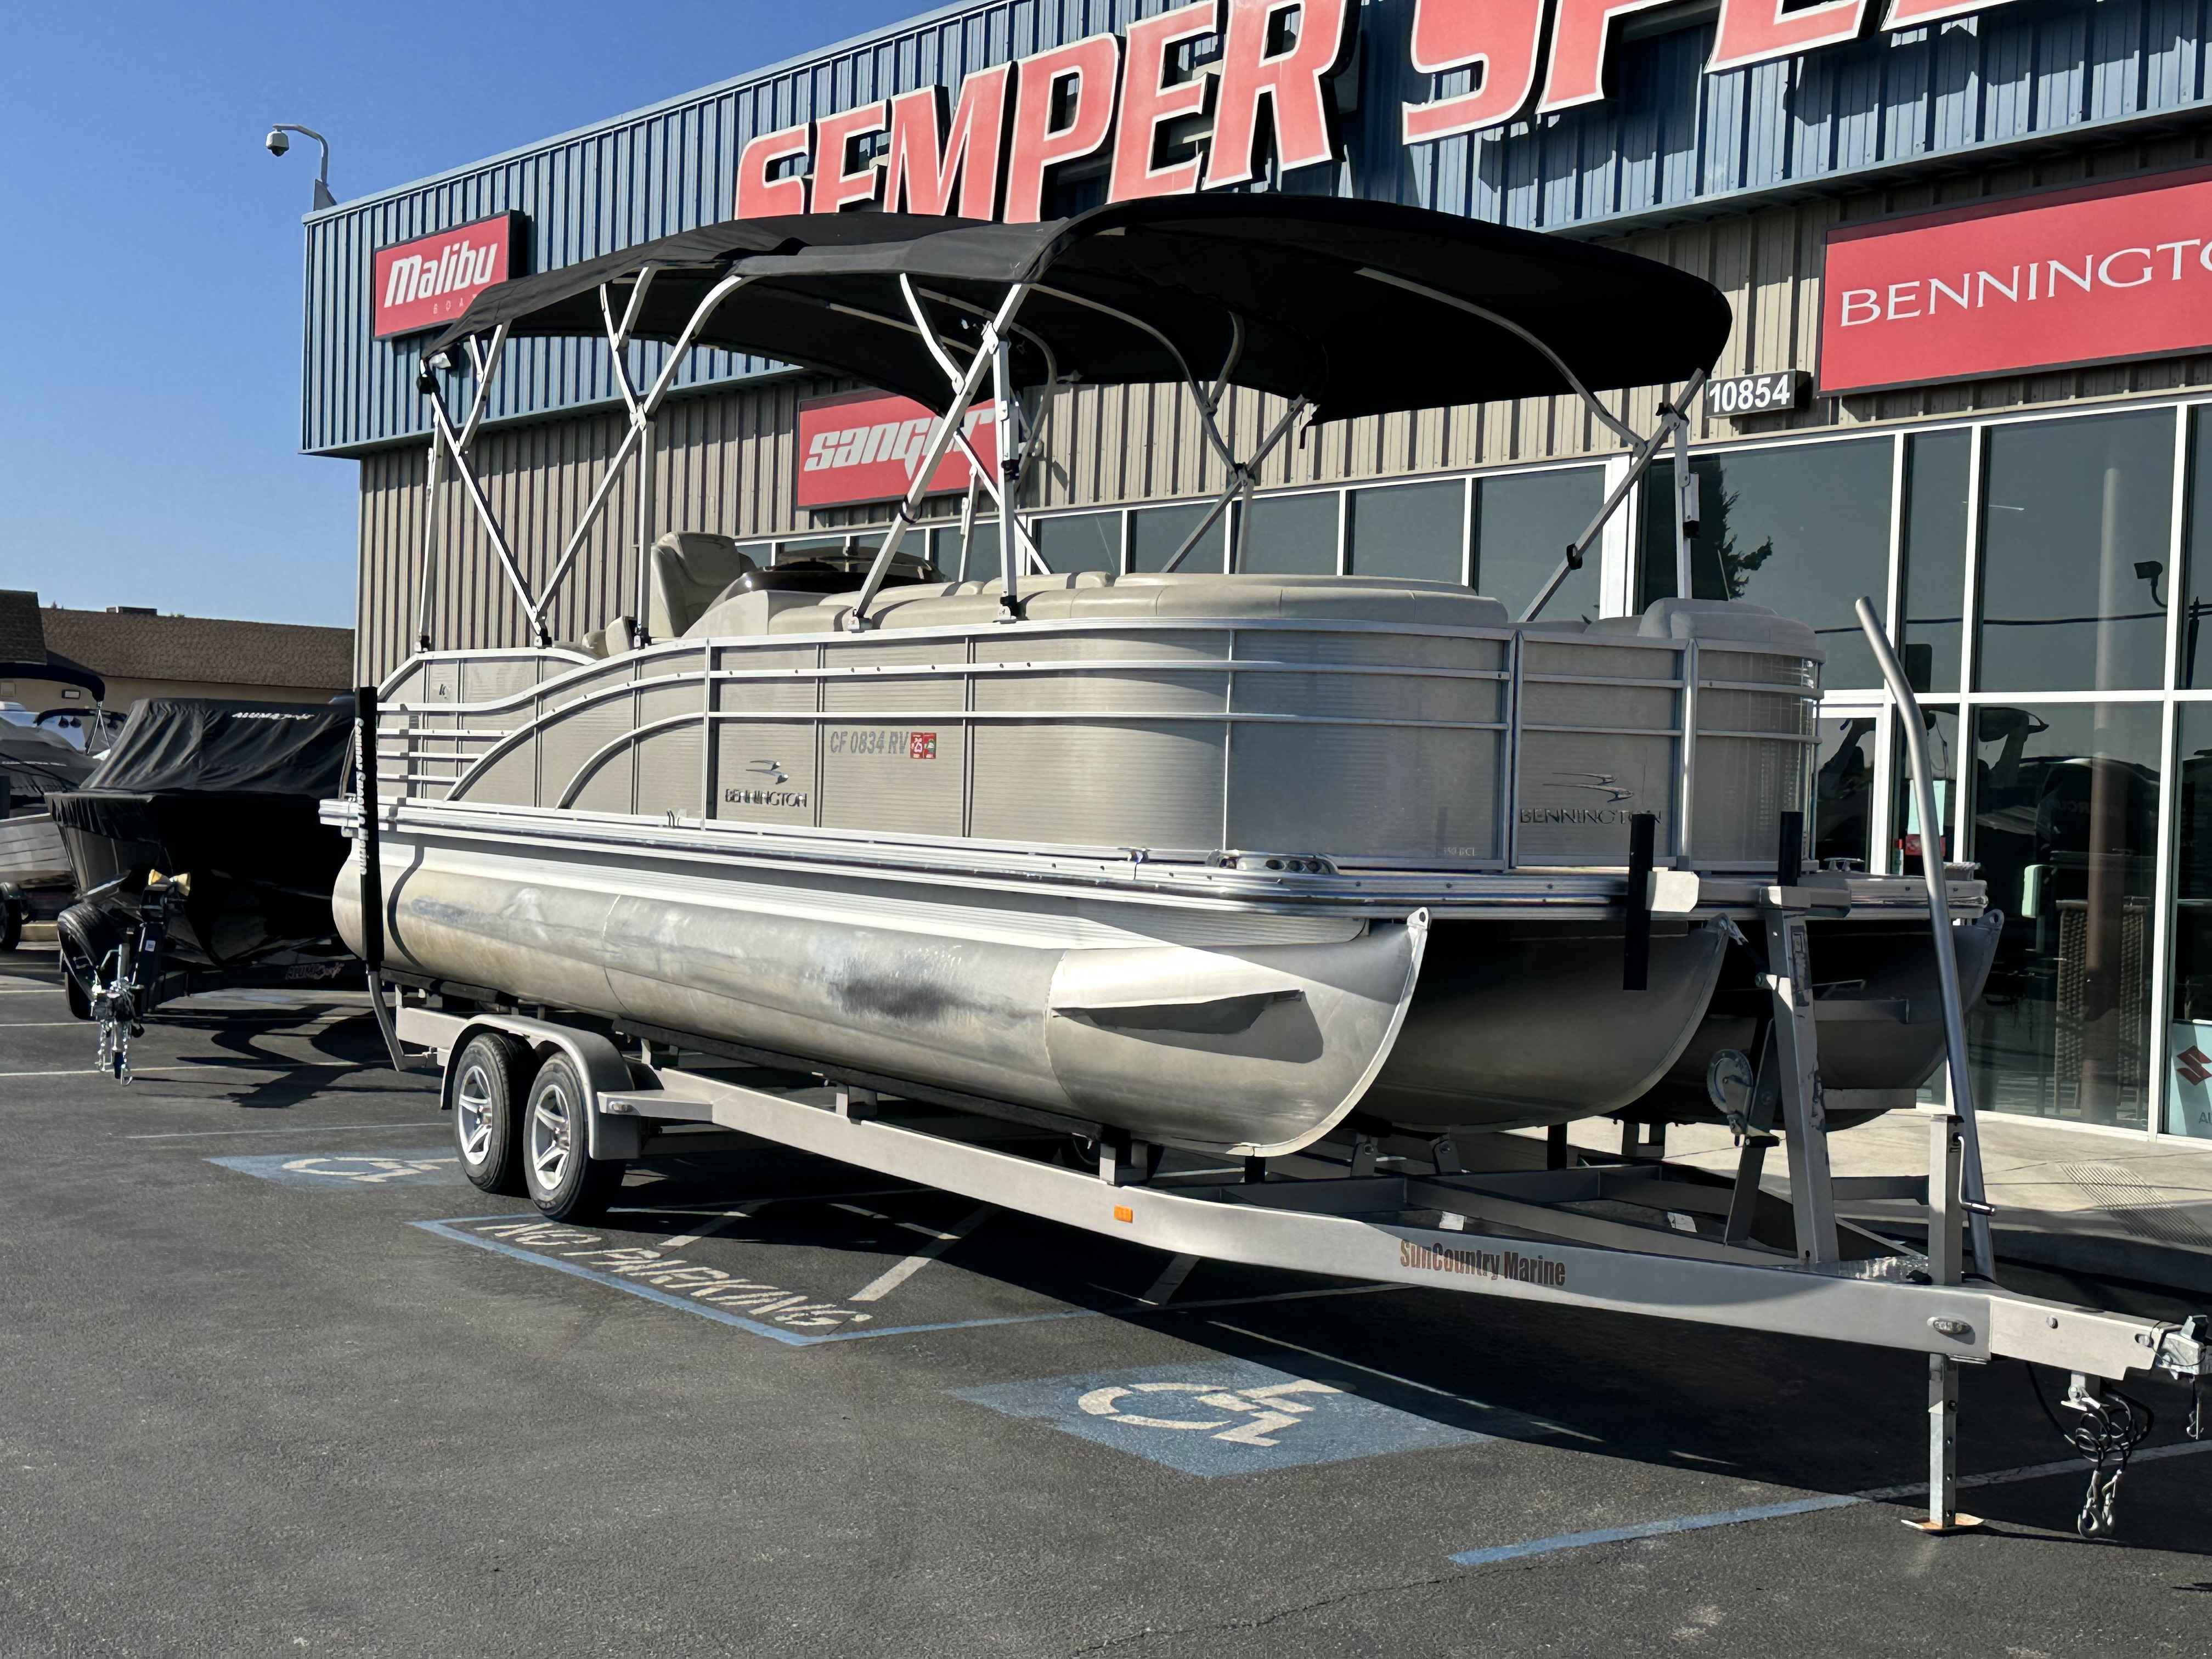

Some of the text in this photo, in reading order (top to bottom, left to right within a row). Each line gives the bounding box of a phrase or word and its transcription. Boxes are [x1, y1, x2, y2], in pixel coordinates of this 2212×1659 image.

[735, 0, 1346, 223] SEMPER
[383, 240, 498, 308] Malibu
[433, 295, 476, 314] BOA
[1709, 375, 1790, 414] 10854
[830, 731, 909, 754] CF 0834 RV
[724, 788, 807, 808] BENNINGTON
[1520, 808, 1661, 824] BENNINGTN
[475, 1221, 873, 1327] NO PARKING
[1400, 1238, 1566, 1286] SunCountry Marine
